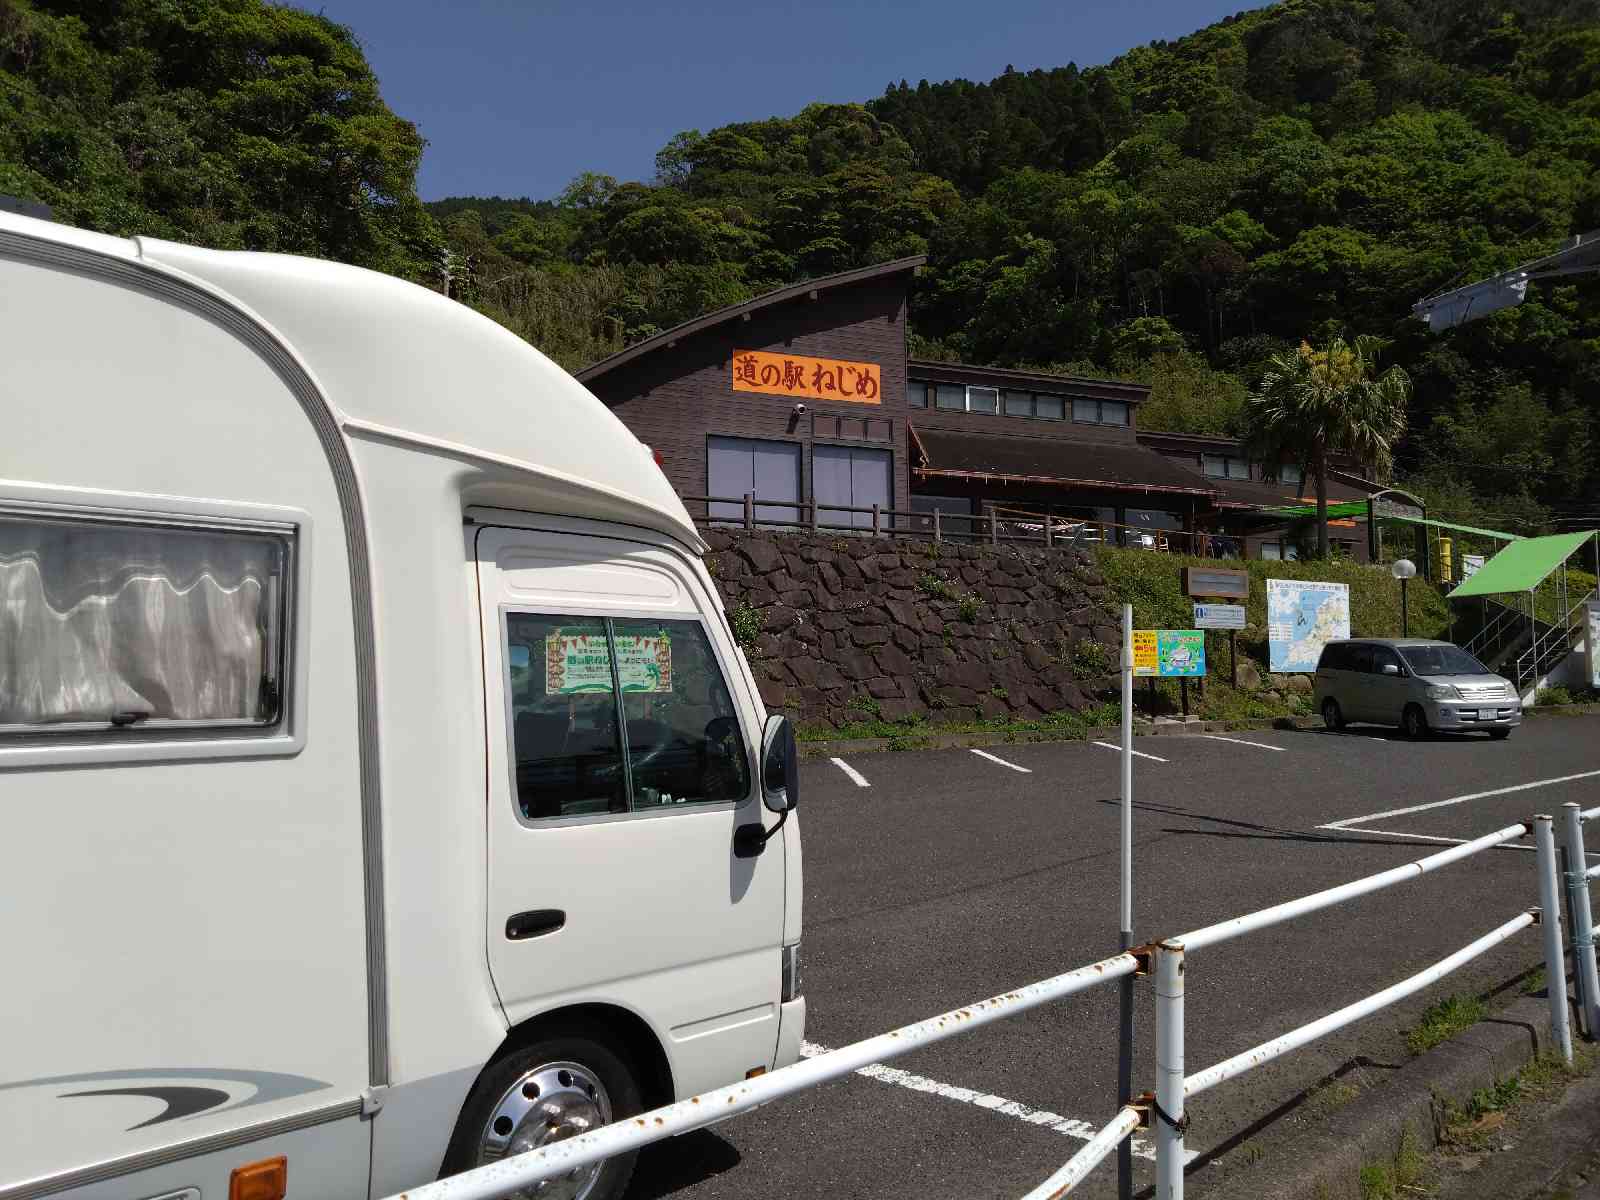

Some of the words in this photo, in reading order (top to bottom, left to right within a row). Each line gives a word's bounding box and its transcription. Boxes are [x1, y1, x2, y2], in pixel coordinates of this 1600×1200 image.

[735, 354, 807, 391] 道の駅
[811, 363, 878, 399] ねじめ
